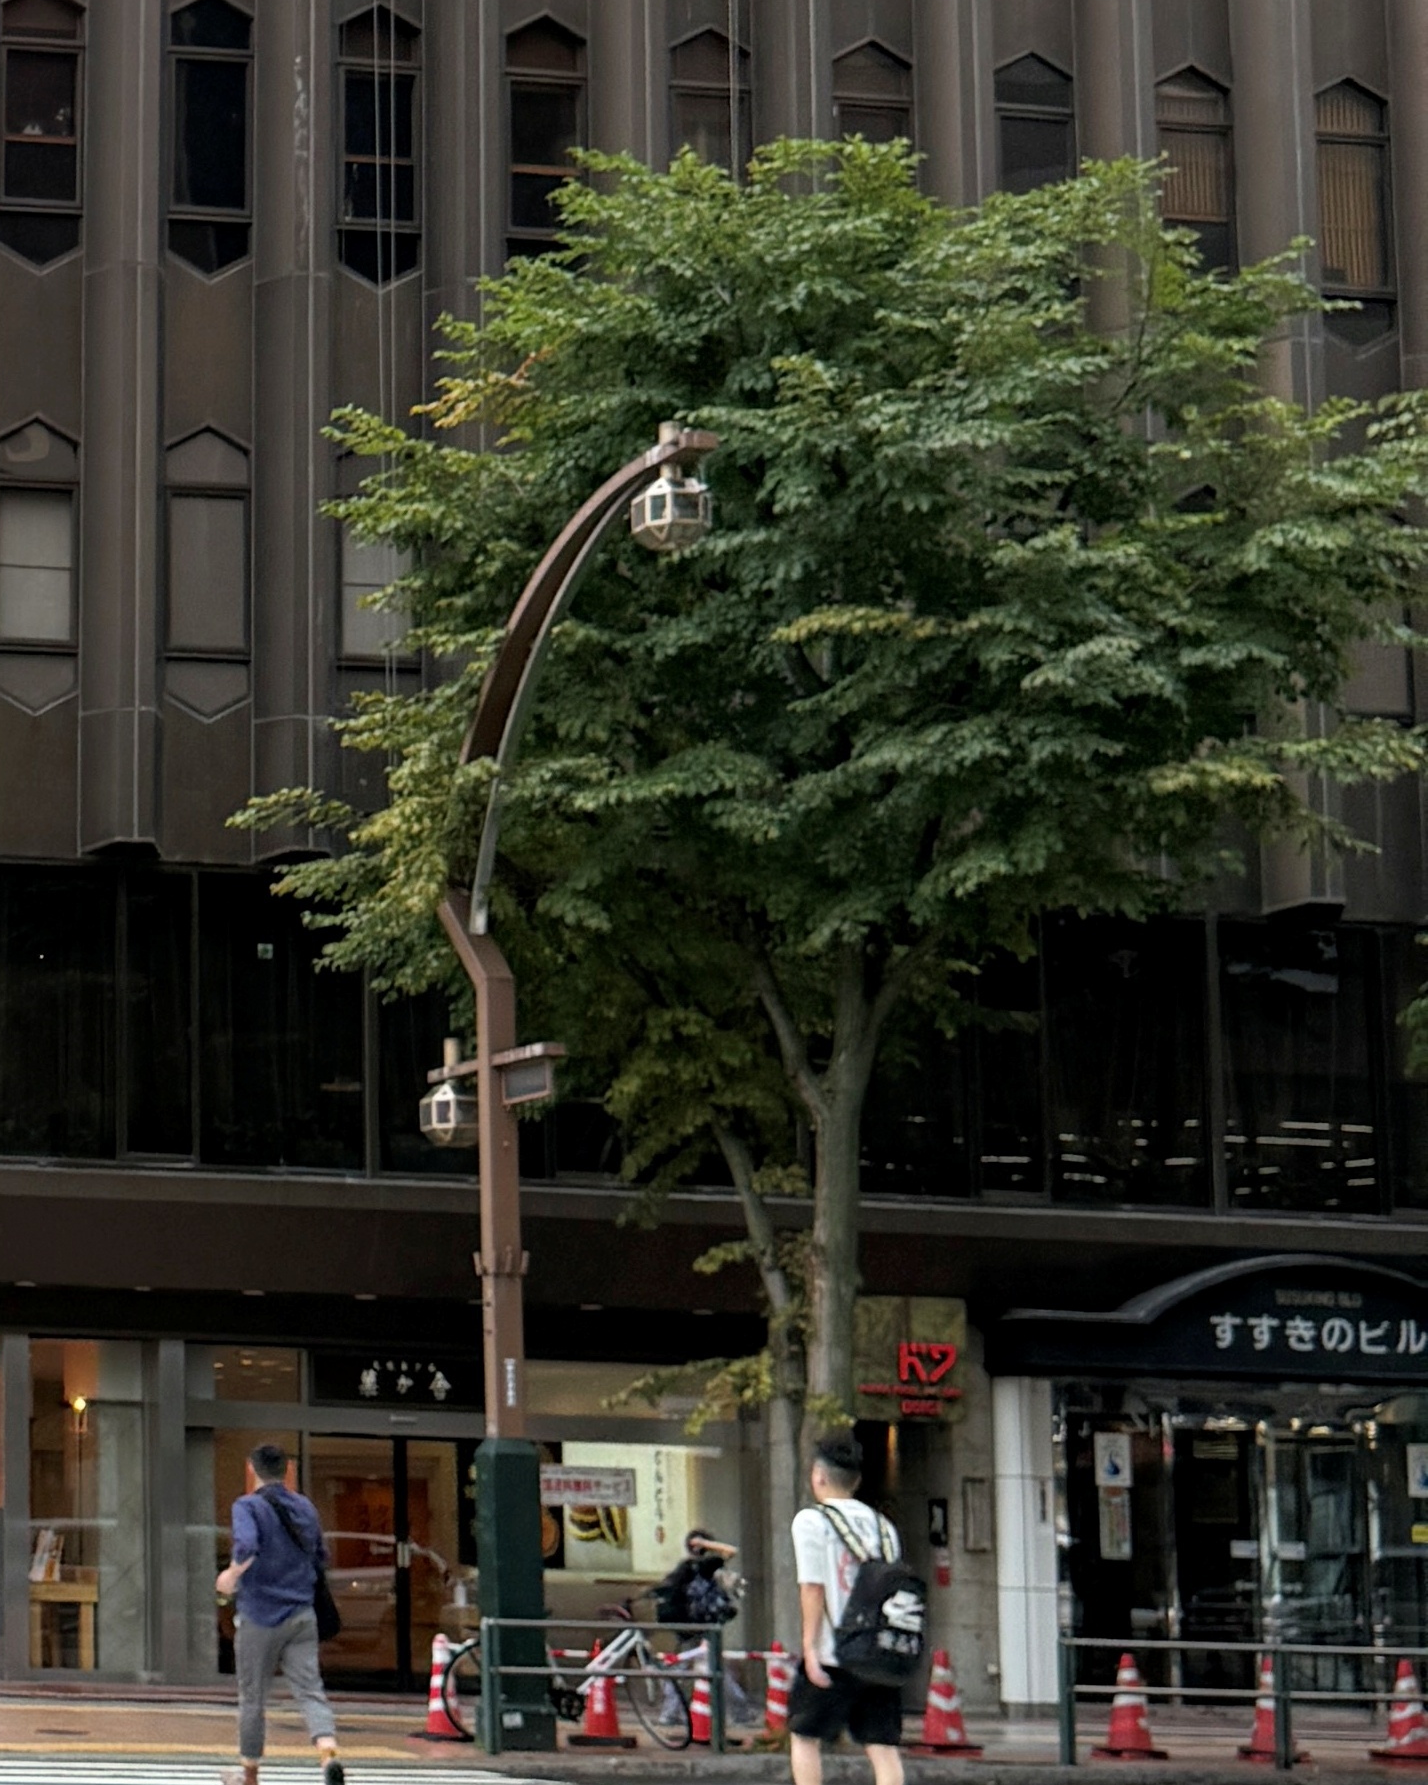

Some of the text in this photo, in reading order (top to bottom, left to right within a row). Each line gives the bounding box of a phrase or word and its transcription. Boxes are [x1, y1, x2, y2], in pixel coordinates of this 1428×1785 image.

[1209, 1311, 1427, 1355] すすきのビル
